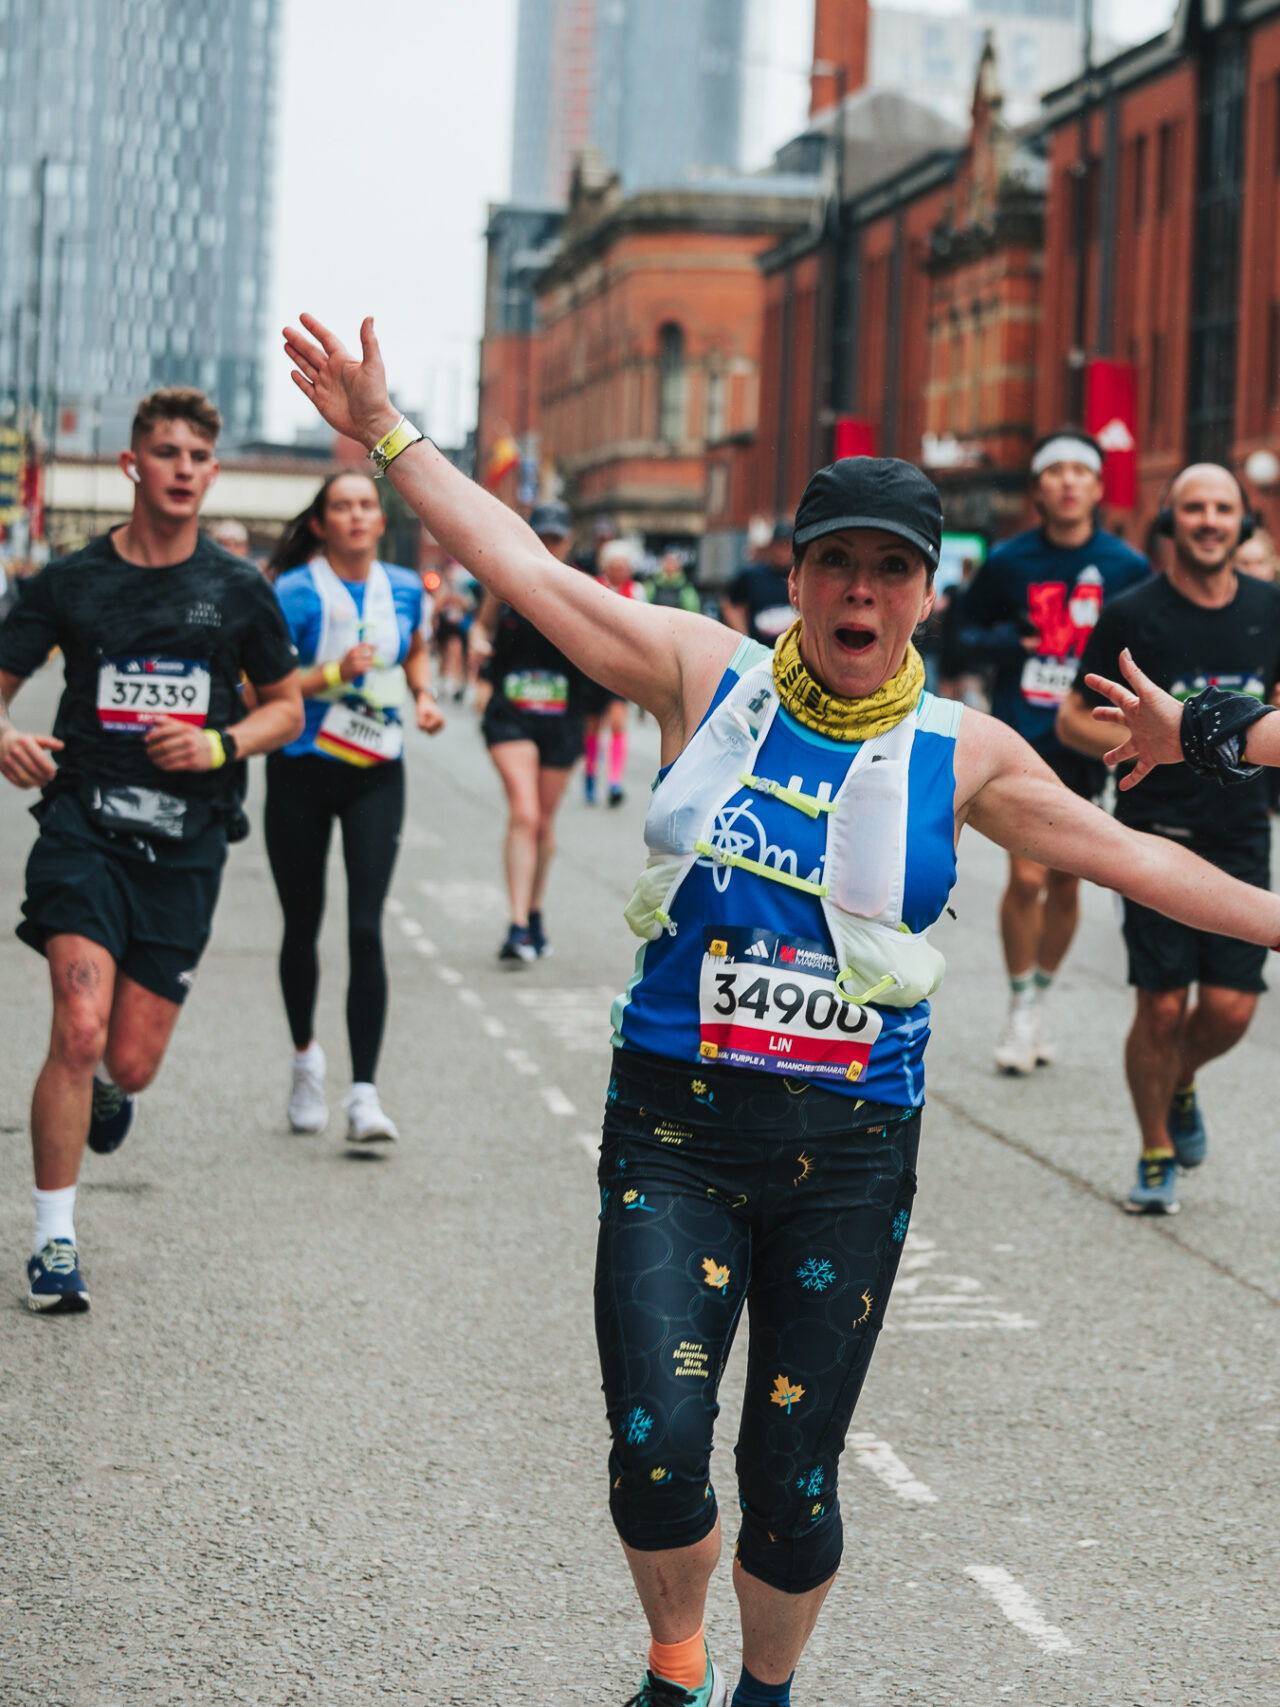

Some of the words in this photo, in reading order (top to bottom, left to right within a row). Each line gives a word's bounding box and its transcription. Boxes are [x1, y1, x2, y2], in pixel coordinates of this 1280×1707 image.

[111, 681, 197, 708] 37339
[713, 973, 868, 1034] 34900
[768, 1035, 793, 1053] LIN
[730, 1052, 759, 1065] PURPLE
[758, 1057, 766, 1067] A
[672, 1349, 709, 1362] Running
[674, 1366, 709, 1379] Running
